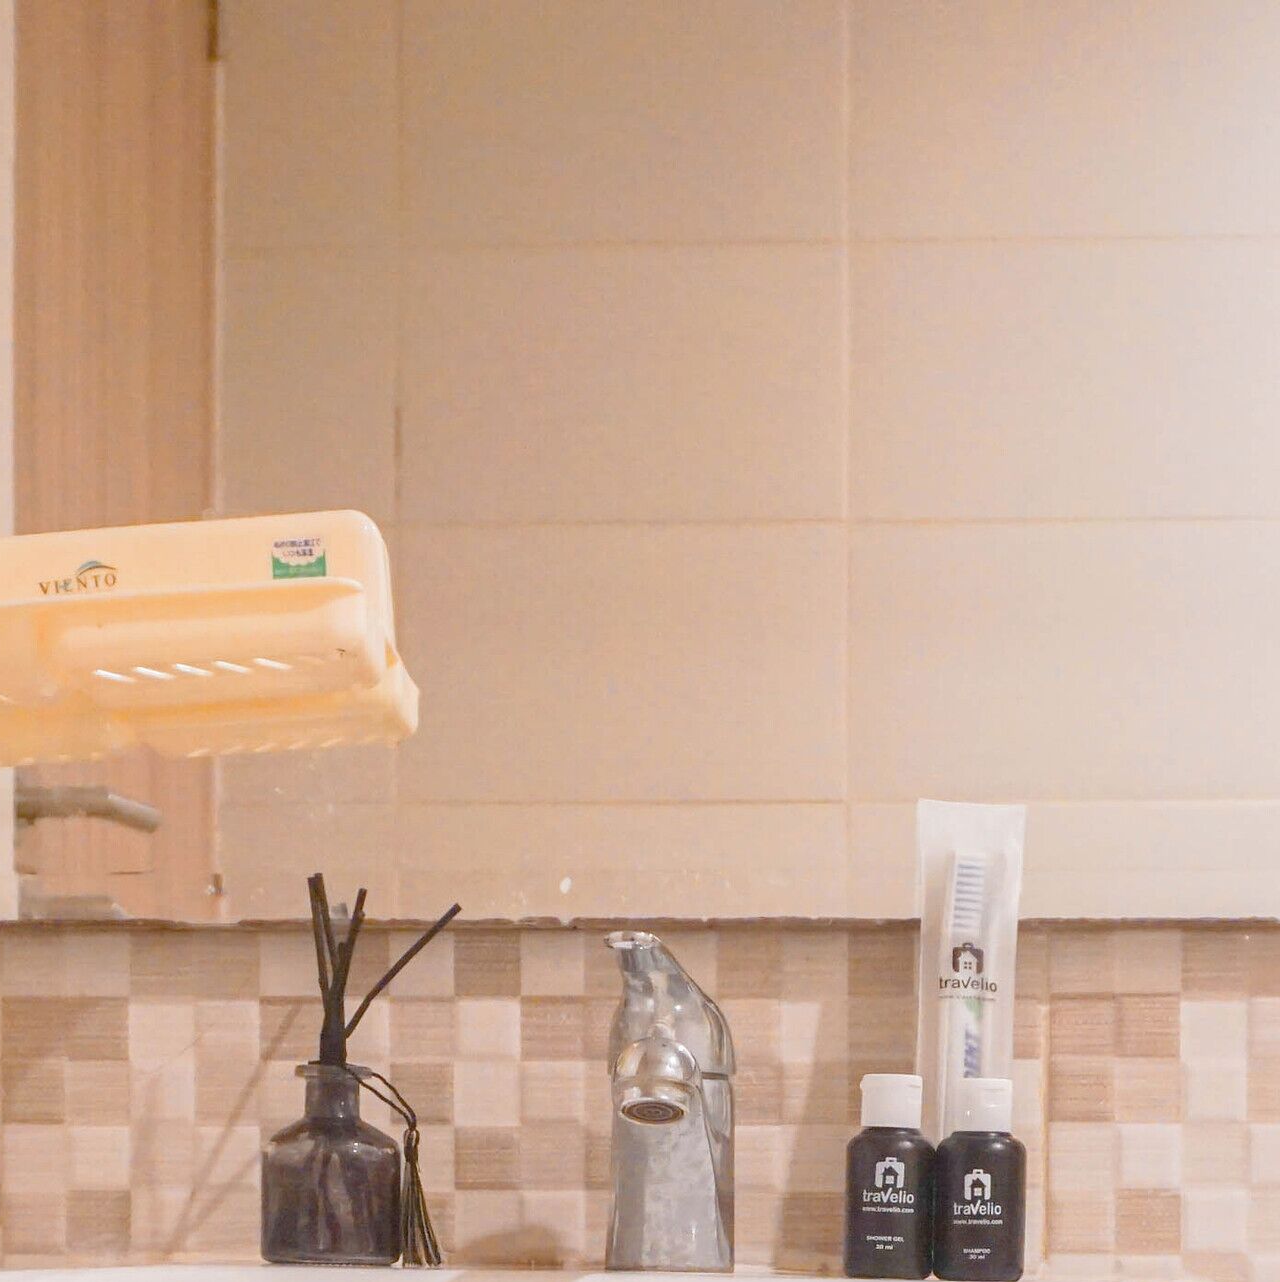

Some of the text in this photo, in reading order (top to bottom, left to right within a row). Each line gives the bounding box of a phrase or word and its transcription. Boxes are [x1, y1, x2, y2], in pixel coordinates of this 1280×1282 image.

[38, 573, 117, 595] VIENTO
[939, 977, 998, 993] travelio
[862, 1206, 915, 1214] www.travelio.com
[953, 1218, 1004, 1226] www.travelio.com
[893, 1235, 905, 1243] GEL
